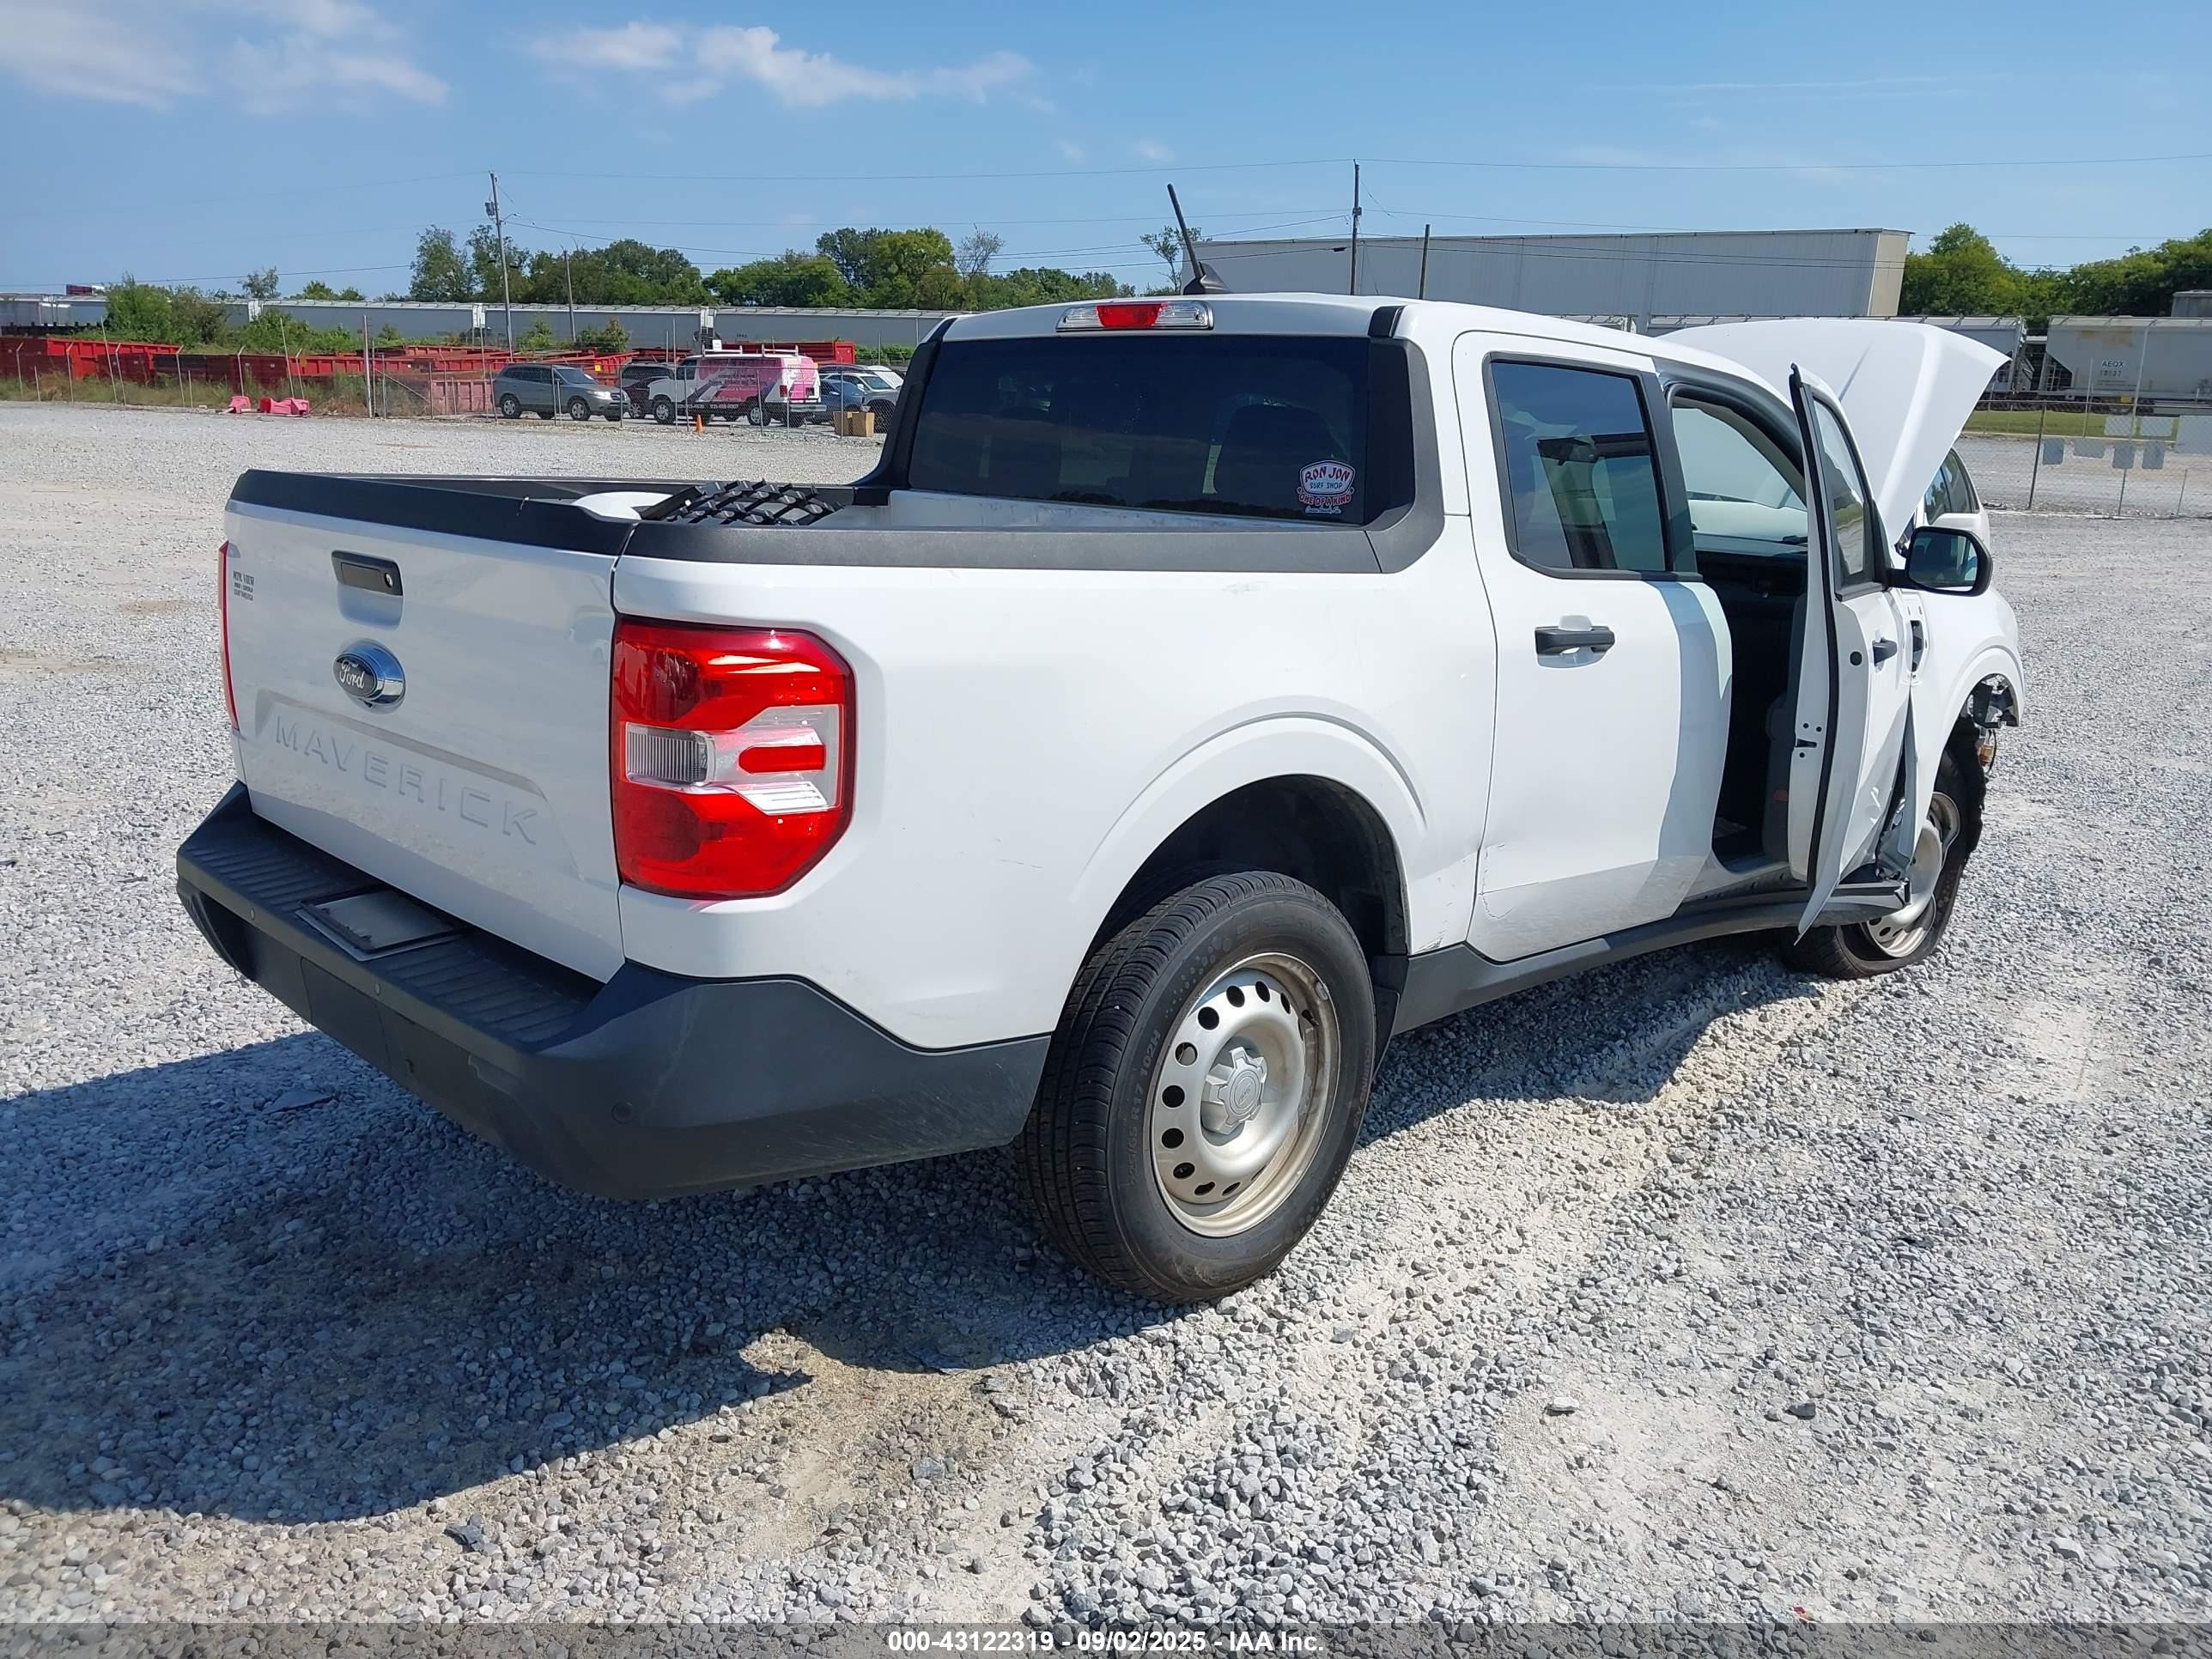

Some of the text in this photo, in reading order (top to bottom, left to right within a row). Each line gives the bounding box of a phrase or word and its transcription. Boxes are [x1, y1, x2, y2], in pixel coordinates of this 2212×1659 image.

[1305, 466, 1350, 483] RON JON
[1298, 493, 1315, 505] ONE
[1333, 494, 1352, 506] KIND
[340, 659, 365, 690] Ford
[276, 714, 537, 846] MAVERICK
[1139, 1030, 1161, 1078] 102H
